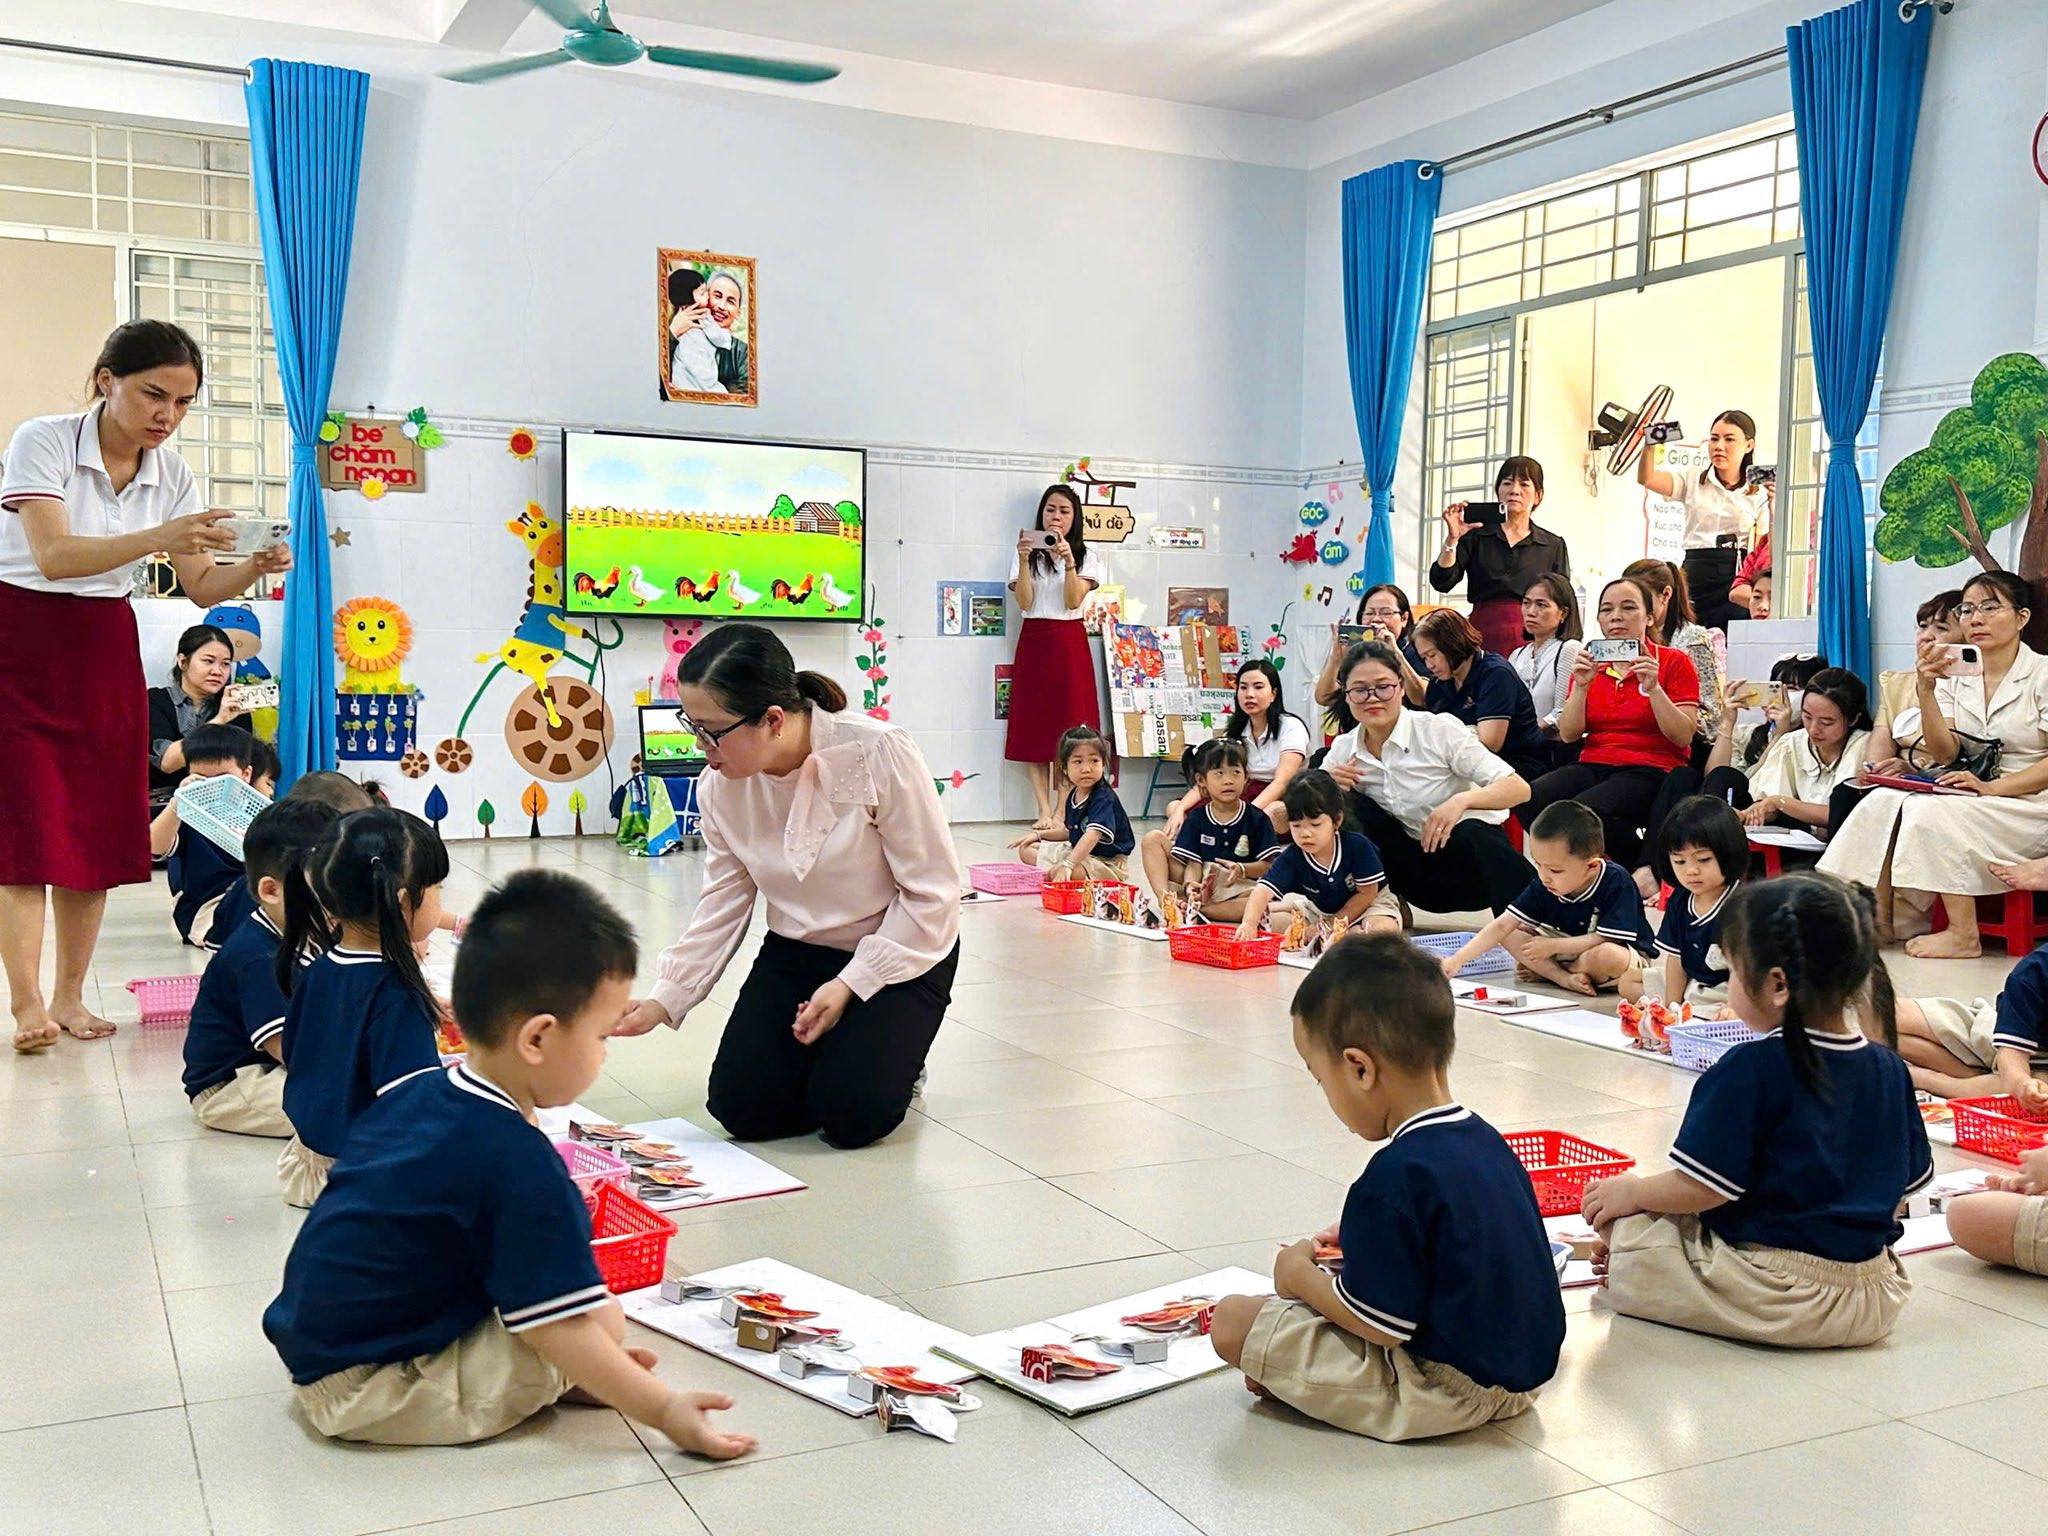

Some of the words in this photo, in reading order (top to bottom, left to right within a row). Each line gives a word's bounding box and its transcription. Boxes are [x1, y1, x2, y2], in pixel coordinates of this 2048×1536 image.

[351, 423, 386, 442] bé
[330, 443, 396, 464] chăm
[1082, 512, 1101, 529] hủ
[1106, 514, 1124, 530] đề
[1324, 543, 1343, 559] âm
